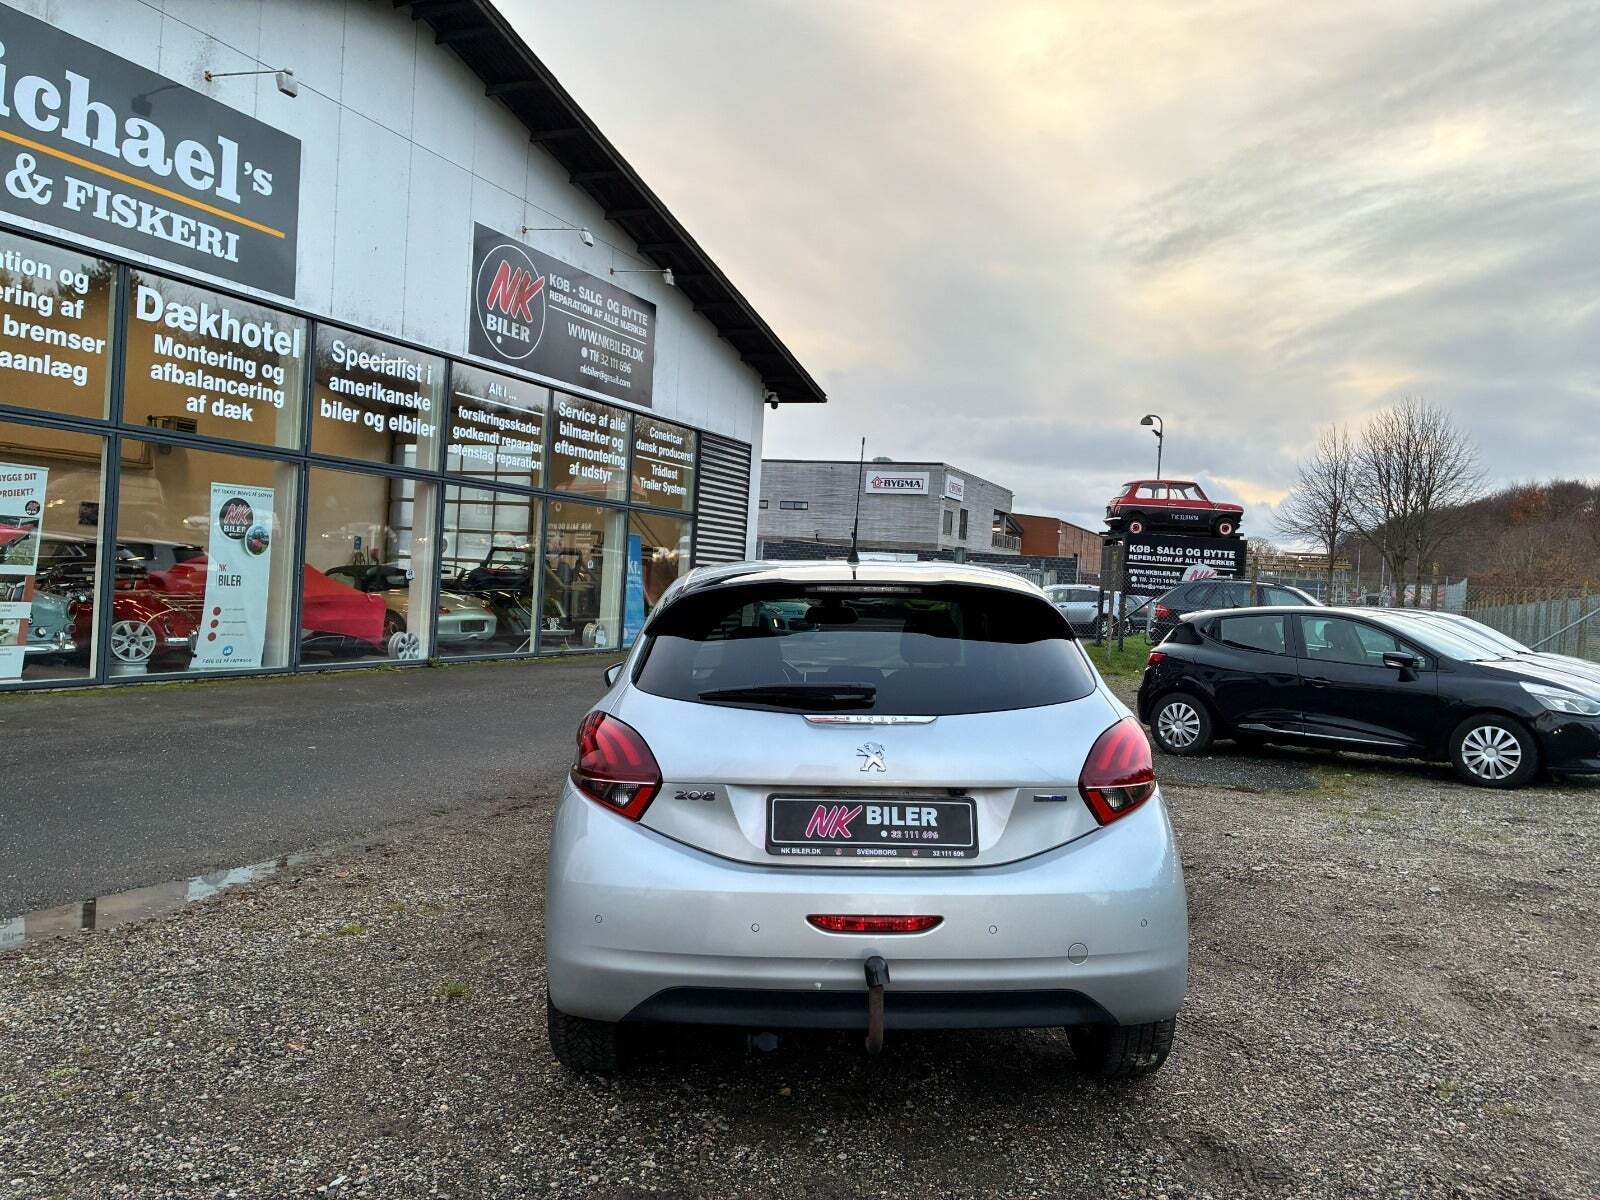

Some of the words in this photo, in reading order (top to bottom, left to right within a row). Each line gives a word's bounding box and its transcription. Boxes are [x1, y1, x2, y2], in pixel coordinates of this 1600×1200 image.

[5, 153, 53, 206] &
[63, 176, 240, 263] FISKERI
[60, 268, 89, 294] og
[486, 259, 546, 323] NK
[61, 299, 85, 319] af
[549, 273, 570, 293] KØB
[578, 286, 602, 307] SALG
[607, 298, 620, 313] OG
[621, 304, 648, 326] BYTTE
[136, 285, 300, 358] Dækhotel
[486, 313, 530, 343] BILER
[549, 291, 592, 316] REPARATION
[594, 308, 602, 319] AF
[604, 311, 619, 327] ALLE
[620, 317, 647, 338] MÆRKER
[4, 314, 106, 354] bremser
[567, 322, 643, 362] WWW.NKBILER.DK
[0, 350, 88, 387] aanlæg
[154, 334, 257, 378] Montering
[262, 363, 285, 385] og
[331, 339, 424, 382] Specialist
[426, 364, 432, 385] i
[601, 353, 609, 366] 32
[619, 359, 632, 374] 696
[151, 362, 285, 408] afbalancering
[488, 382, 502, 397] Alt
[580, 364, 631, 388] nkbiler@gmail.com
[329, 374, 431, 412] amerikanske
[187, 396, 208, 414] af
[212, 398, 254, 422] dæk
[320, 398, 359, 423] biler
[364, 411, 384, 432] og
[389, 415, 435, 438] elbiler
[458, 405, 541, 436] forsikringsskader
[558, 401, 597, 425] Service
[598, 415, 609, 428] af
[610, 417, 626, 432] alle
[452, 425, 500, 445] godkendt
[501, 435, 543, 454] reparatør
[559, 421, 610, 446] bilmærker
[612, 437, 624, 452] og
[635, 438, 657, 454] dansk
[658, 444, 694, 463] produceret
[451, 443, 495, 465] stenslag
[496, 451, 542, 471] reparation
[554, 440, 626, 471] eftermontering
[24, 472, 37, 480] DIT
[569, 461, 580, 476] af
[581, 465, 612, 484] udstyr
[640, 477, 662, 492] Trailer
[662, 481, 687, 496] System
[884, 480, 921, 488] BYGMA
[1128, 554, 1173, 564] REPERATION
[1185, 558, 1202, 566] ALLE
[1204, 559, 1236, 567] MÆRKER
[1156, 546, 1183, 556] SALG
[1186, 548, 1201, 557] OG
[1203, 549, 1236, 560] BYTTE
[218, 574, 242, 587] BILER
[1128, 568, 1180, 577] WWW.NKBILER.DK
[674, 790, 716, 802] 208
[805, 804, 863, 839] NK
[866, 806, 938, 828] BILER
[891, 830, 901, 839] 32
[904, 831, 920, 839] 111
